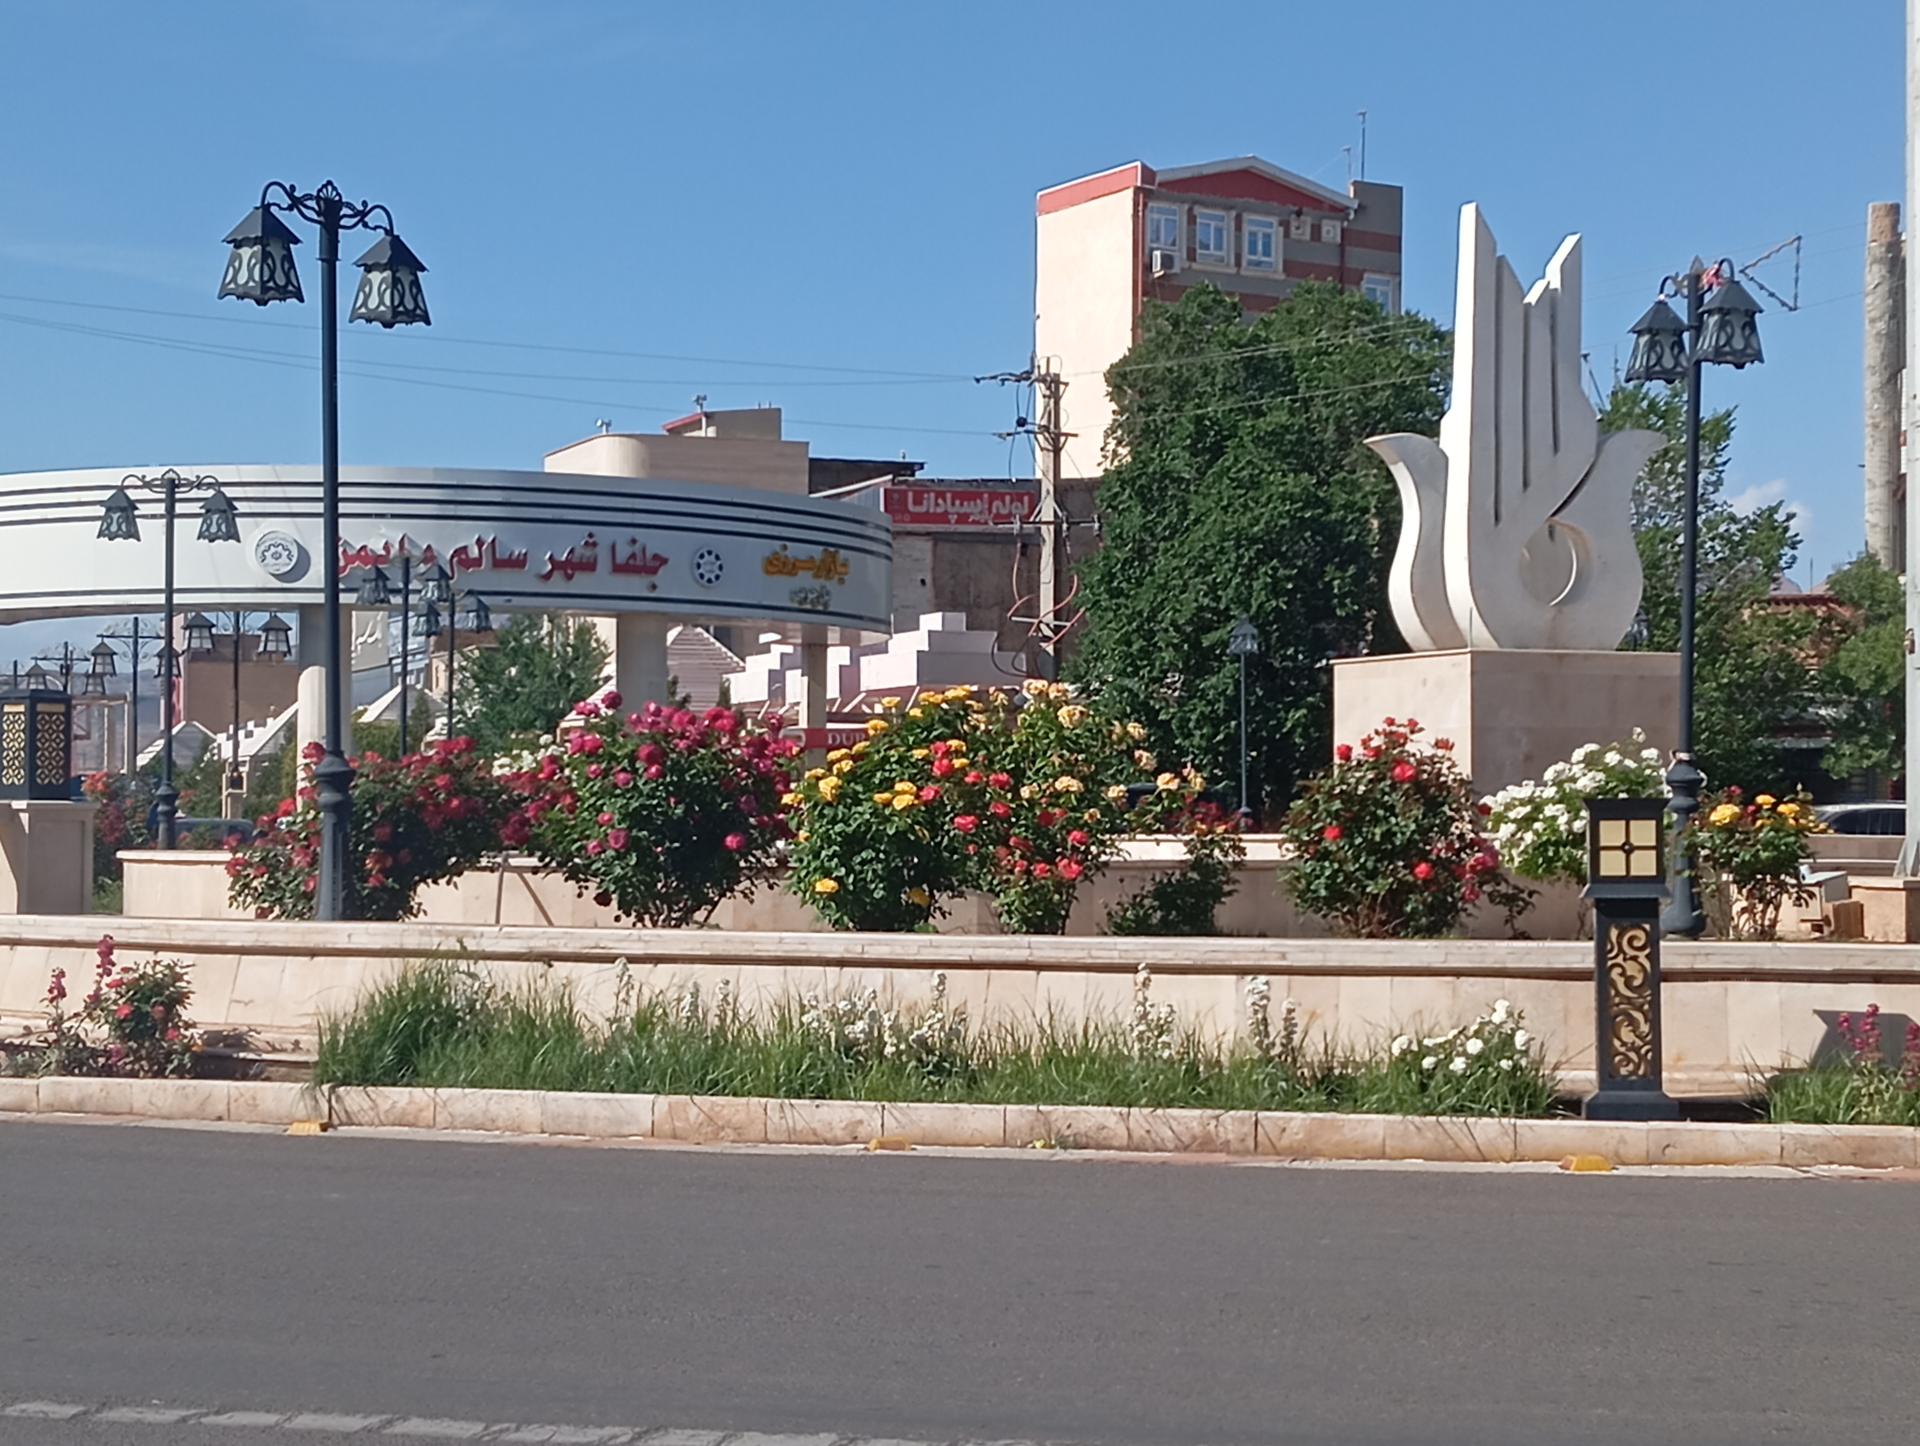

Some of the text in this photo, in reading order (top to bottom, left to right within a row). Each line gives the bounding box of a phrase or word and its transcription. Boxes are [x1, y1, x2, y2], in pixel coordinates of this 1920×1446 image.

[449, 534, 528, 581] سالم
[535, 531, 598, 582] شهر
[610, 537, 670, 593] جلفا
